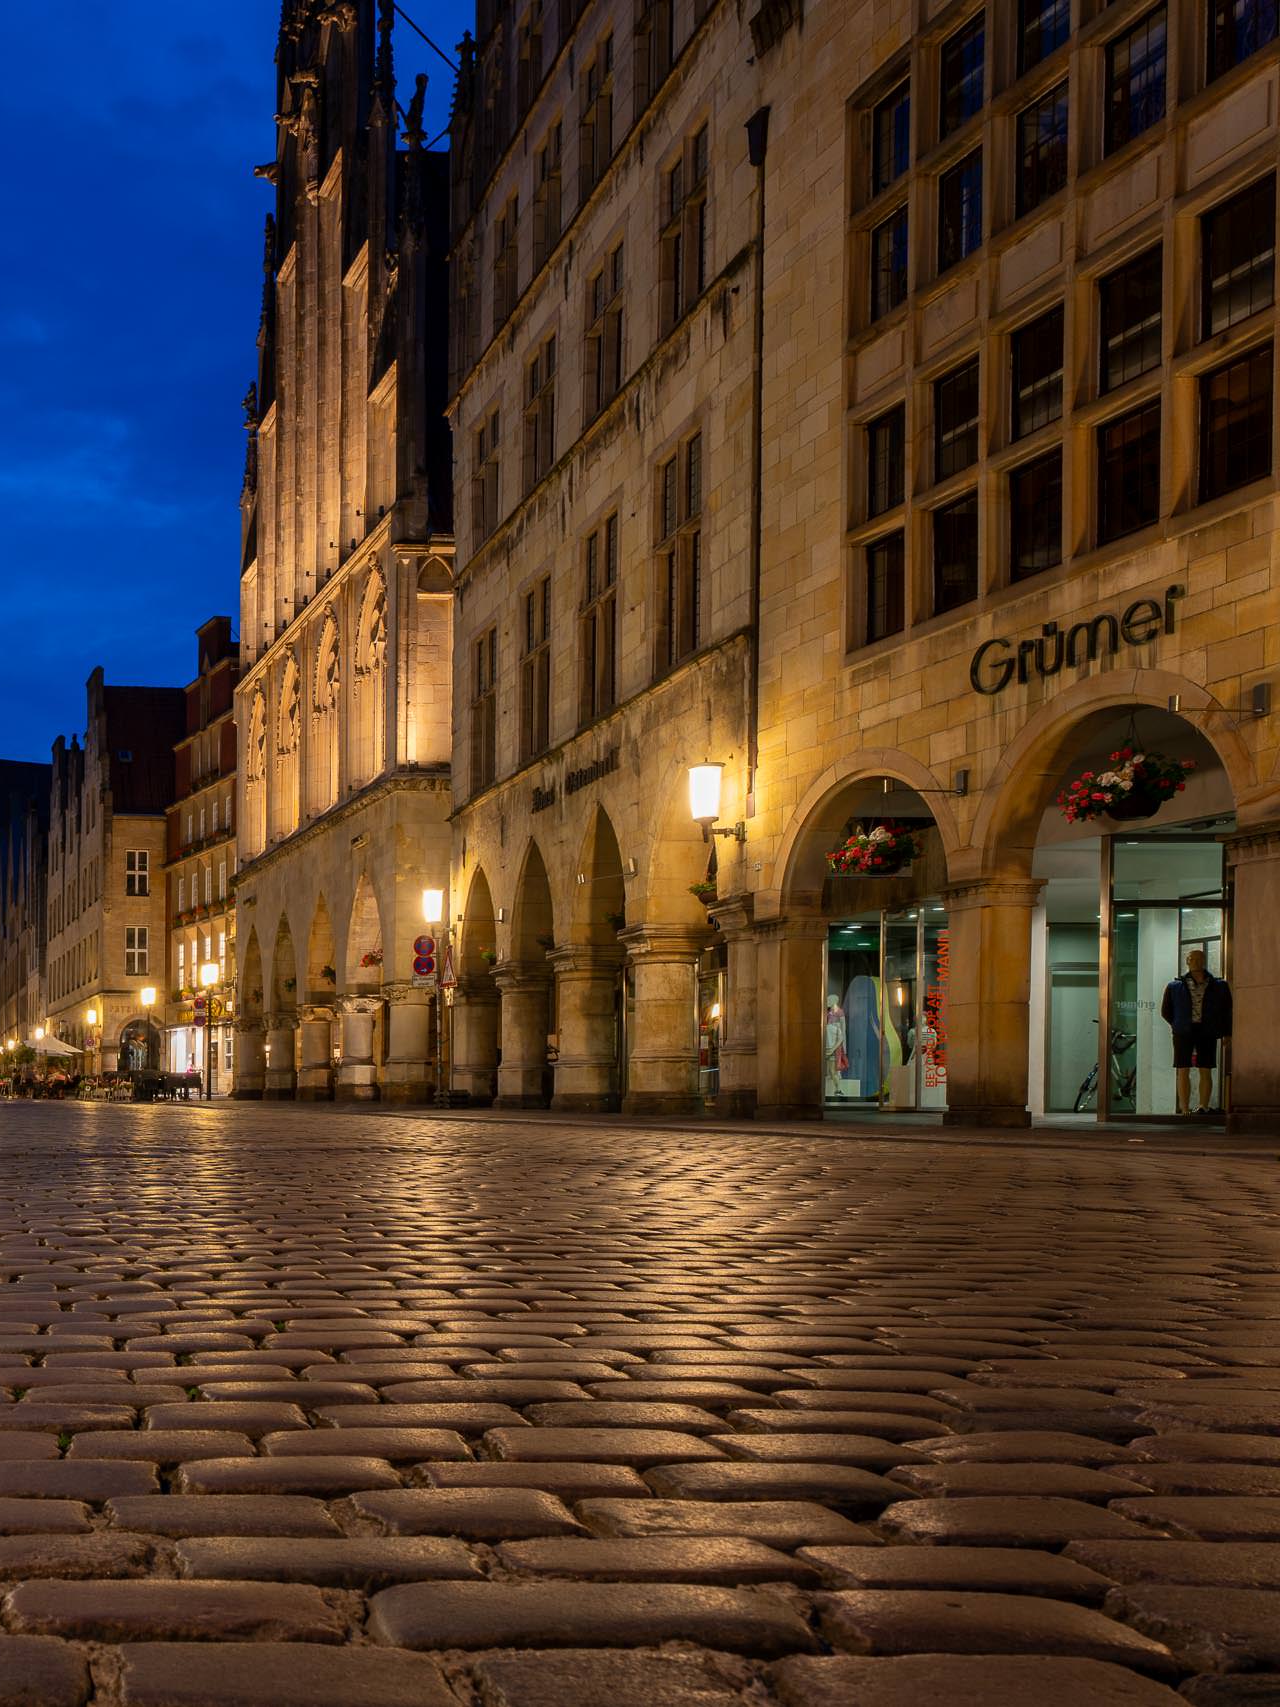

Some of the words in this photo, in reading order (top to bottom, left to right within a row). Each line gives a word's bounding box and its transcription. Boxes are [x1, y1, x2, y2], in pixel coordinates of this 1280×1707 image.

[970, 584, 1185, 695] Grümer
[928, 985, 937, 1008] ART
[927, 1010, 936, 1035] POP
[925, 1038, 935, 1088] BEYOND
[935, 1049, 947, 1088] TOM
